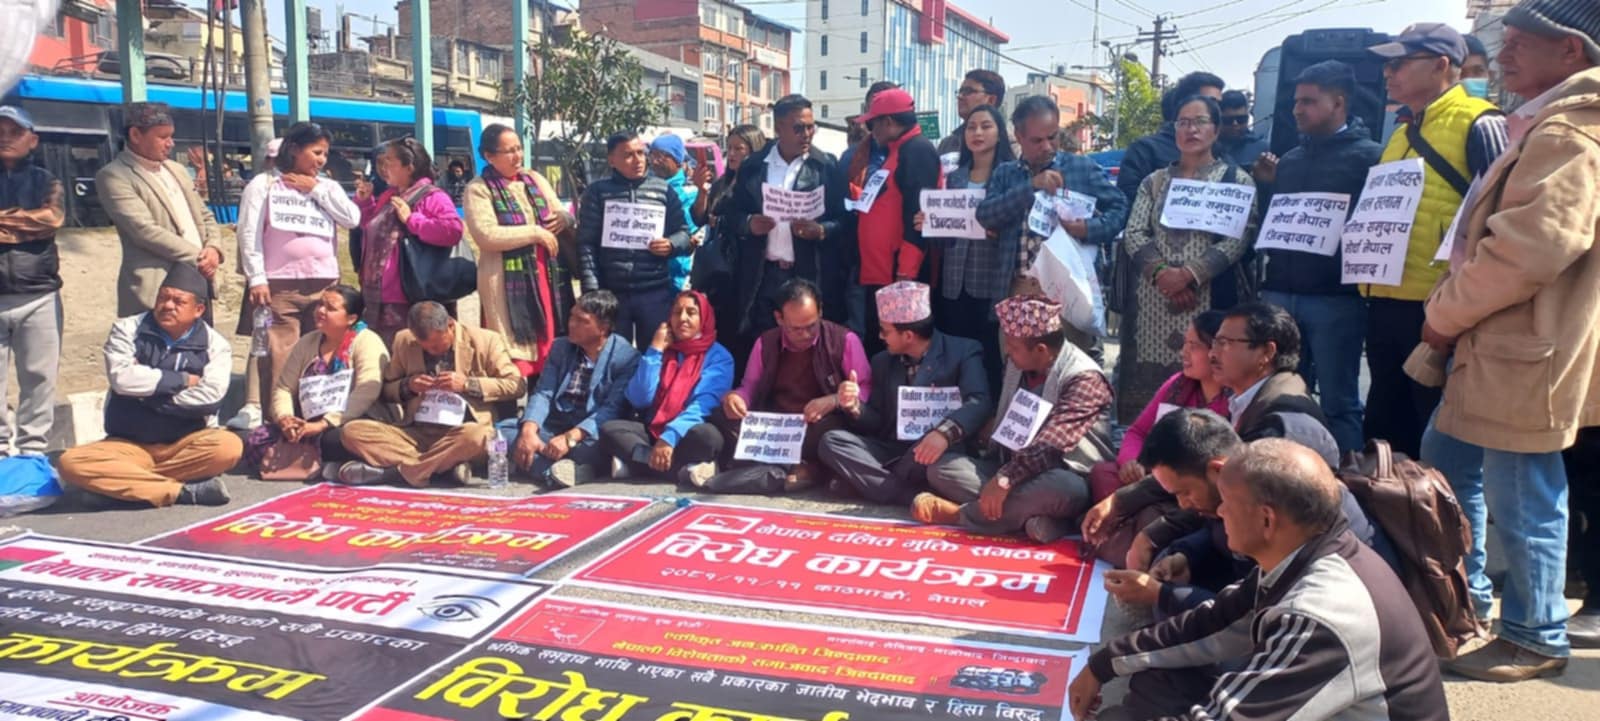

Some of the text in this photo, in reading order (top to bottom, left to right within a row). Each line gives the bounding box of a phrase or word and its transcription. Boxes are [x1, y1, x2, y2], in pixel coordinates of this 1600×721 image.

[1172, 183, 1206, 197] सम्पूर्ण
[1205, 200, 1246, 214] समुदाय
[1303, 198, 1347, 213] समुदाय
[1297, 211, 1332, 228] नेपाल
[1366, 221, 1410, 238] समुदाय
[1264, 228, 1318, 247] जिन्दावाद
[1362, 239, 1393, 255] नेपाल
[213, 512, 357, 542] विरोध
[348, 523, 569, 550] कार्यक्रम
[754, 524, 823, 541] नेपाल
[828, 531, 897, 547] दलित
[901, 538, 960, 553] मुक्ति
[647, 532, 1057, 594] विरोध कार्यक्रम
[20, 559, 137, 583] नेपाल
[127, 573, 320, 605] समाजवादी
[315, 588, 415, 616] पार्टी
[927, 593, 990, 608] नेपाल
[317, 629, 430, 651] प्रकारका
[0, 632, 328, 700] कार्यक्रम
[612, 640, 664, 656] नेपाली
[752, 657, 830, 676] समाजवाद
[834, 665, 917, 686] जिन्दावाद
[812, 647, 891, 665] जिन्दावाद
[413, 657, 650, 721] विरोध
[486, 641, 1044, 721] श्रमिक समुदाय माथि भएका सबै प्रकारका जातीय भेदभाव र हिंसा विरुद्ध
[64, 690, 181, 715] आयोजक
